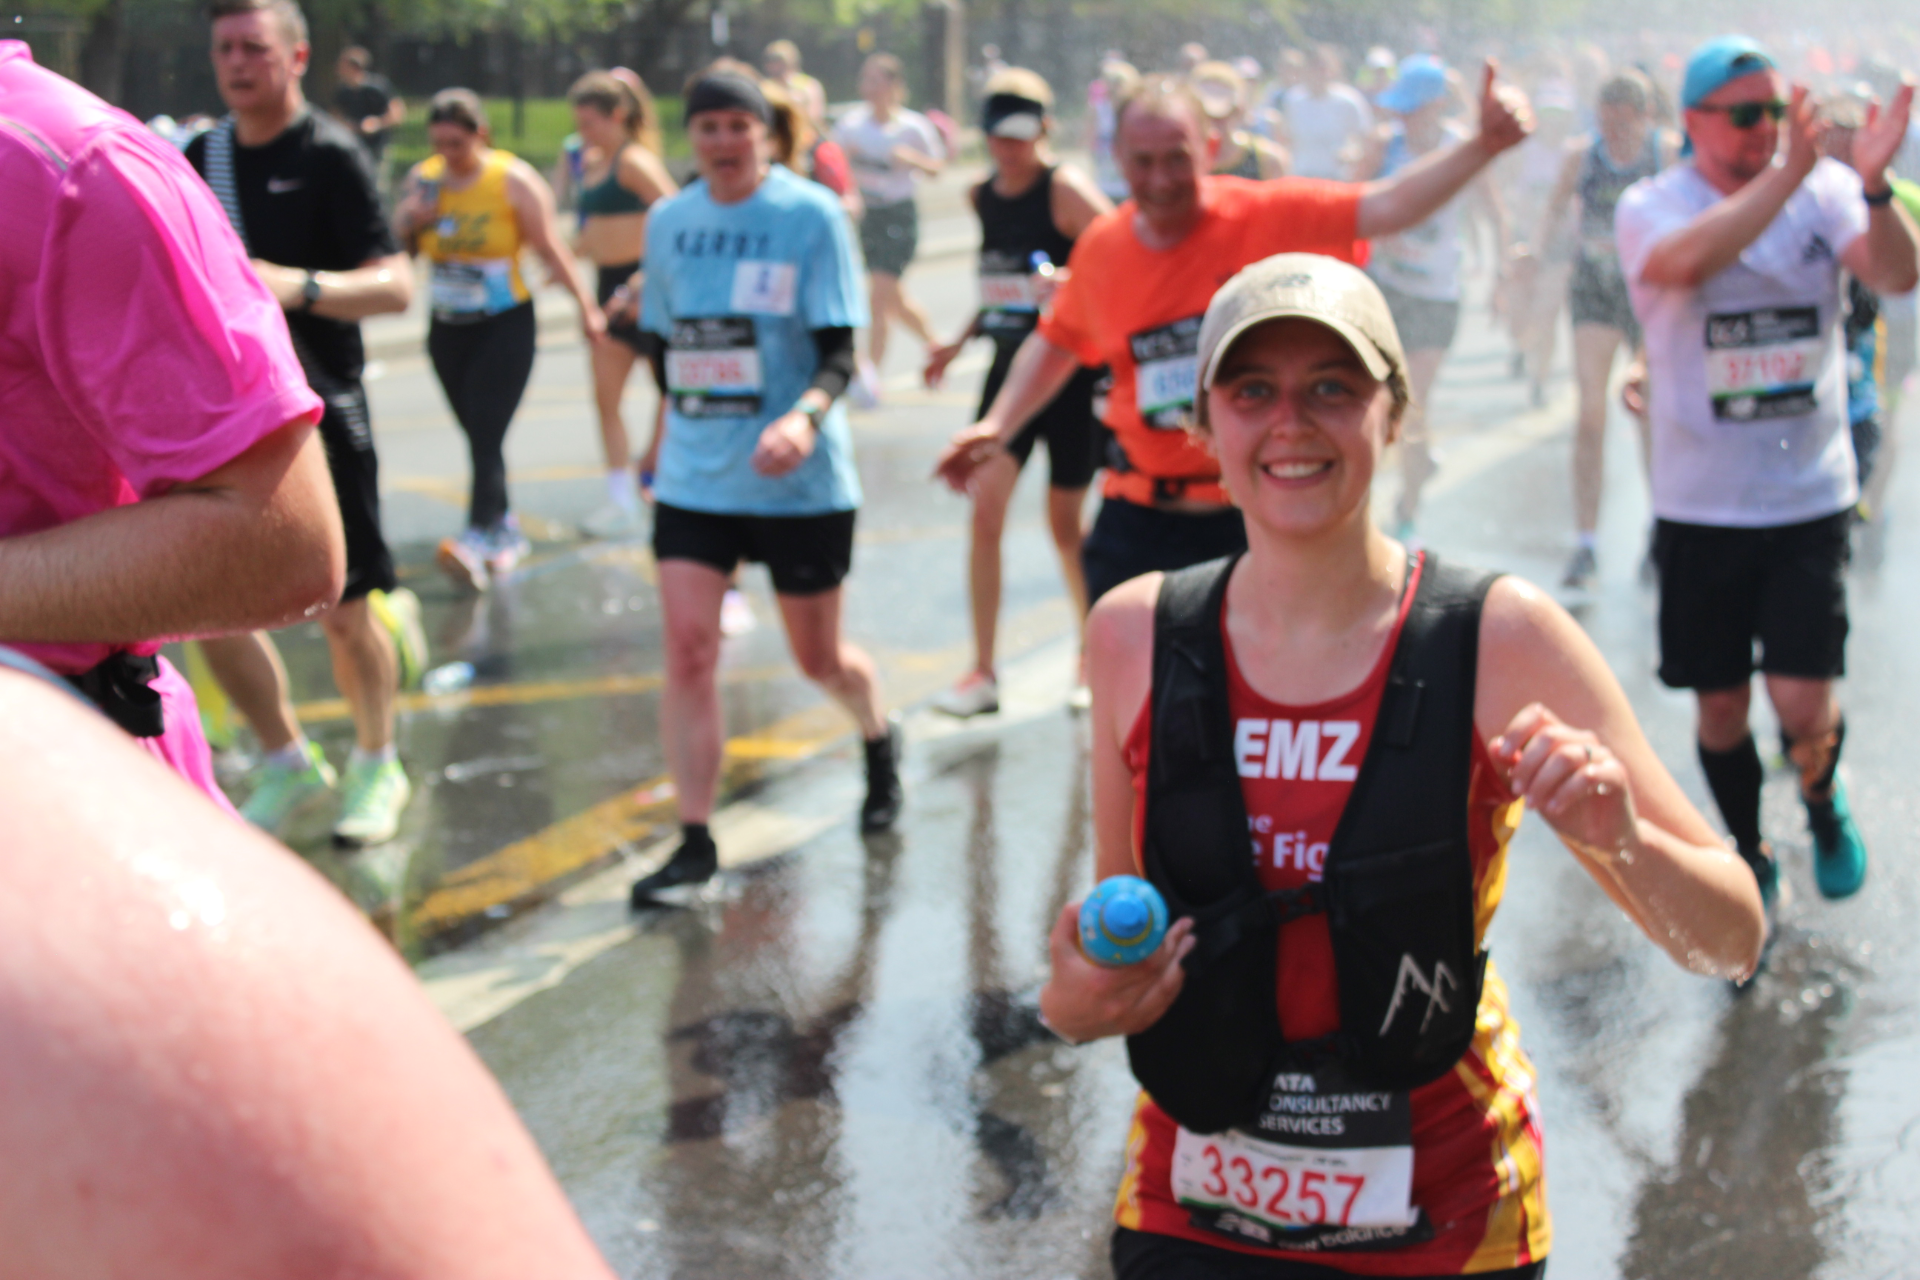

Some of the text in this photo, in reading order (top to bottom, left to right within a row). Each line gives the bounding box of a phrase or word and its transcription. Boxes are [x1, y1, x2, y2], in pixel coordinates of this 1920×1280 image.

[1232, 717, 1361, 782] EMZ
[1258, 1113, 1346, 1135] SERVICES
[1202, 1144, 1365, 1226] 33257
